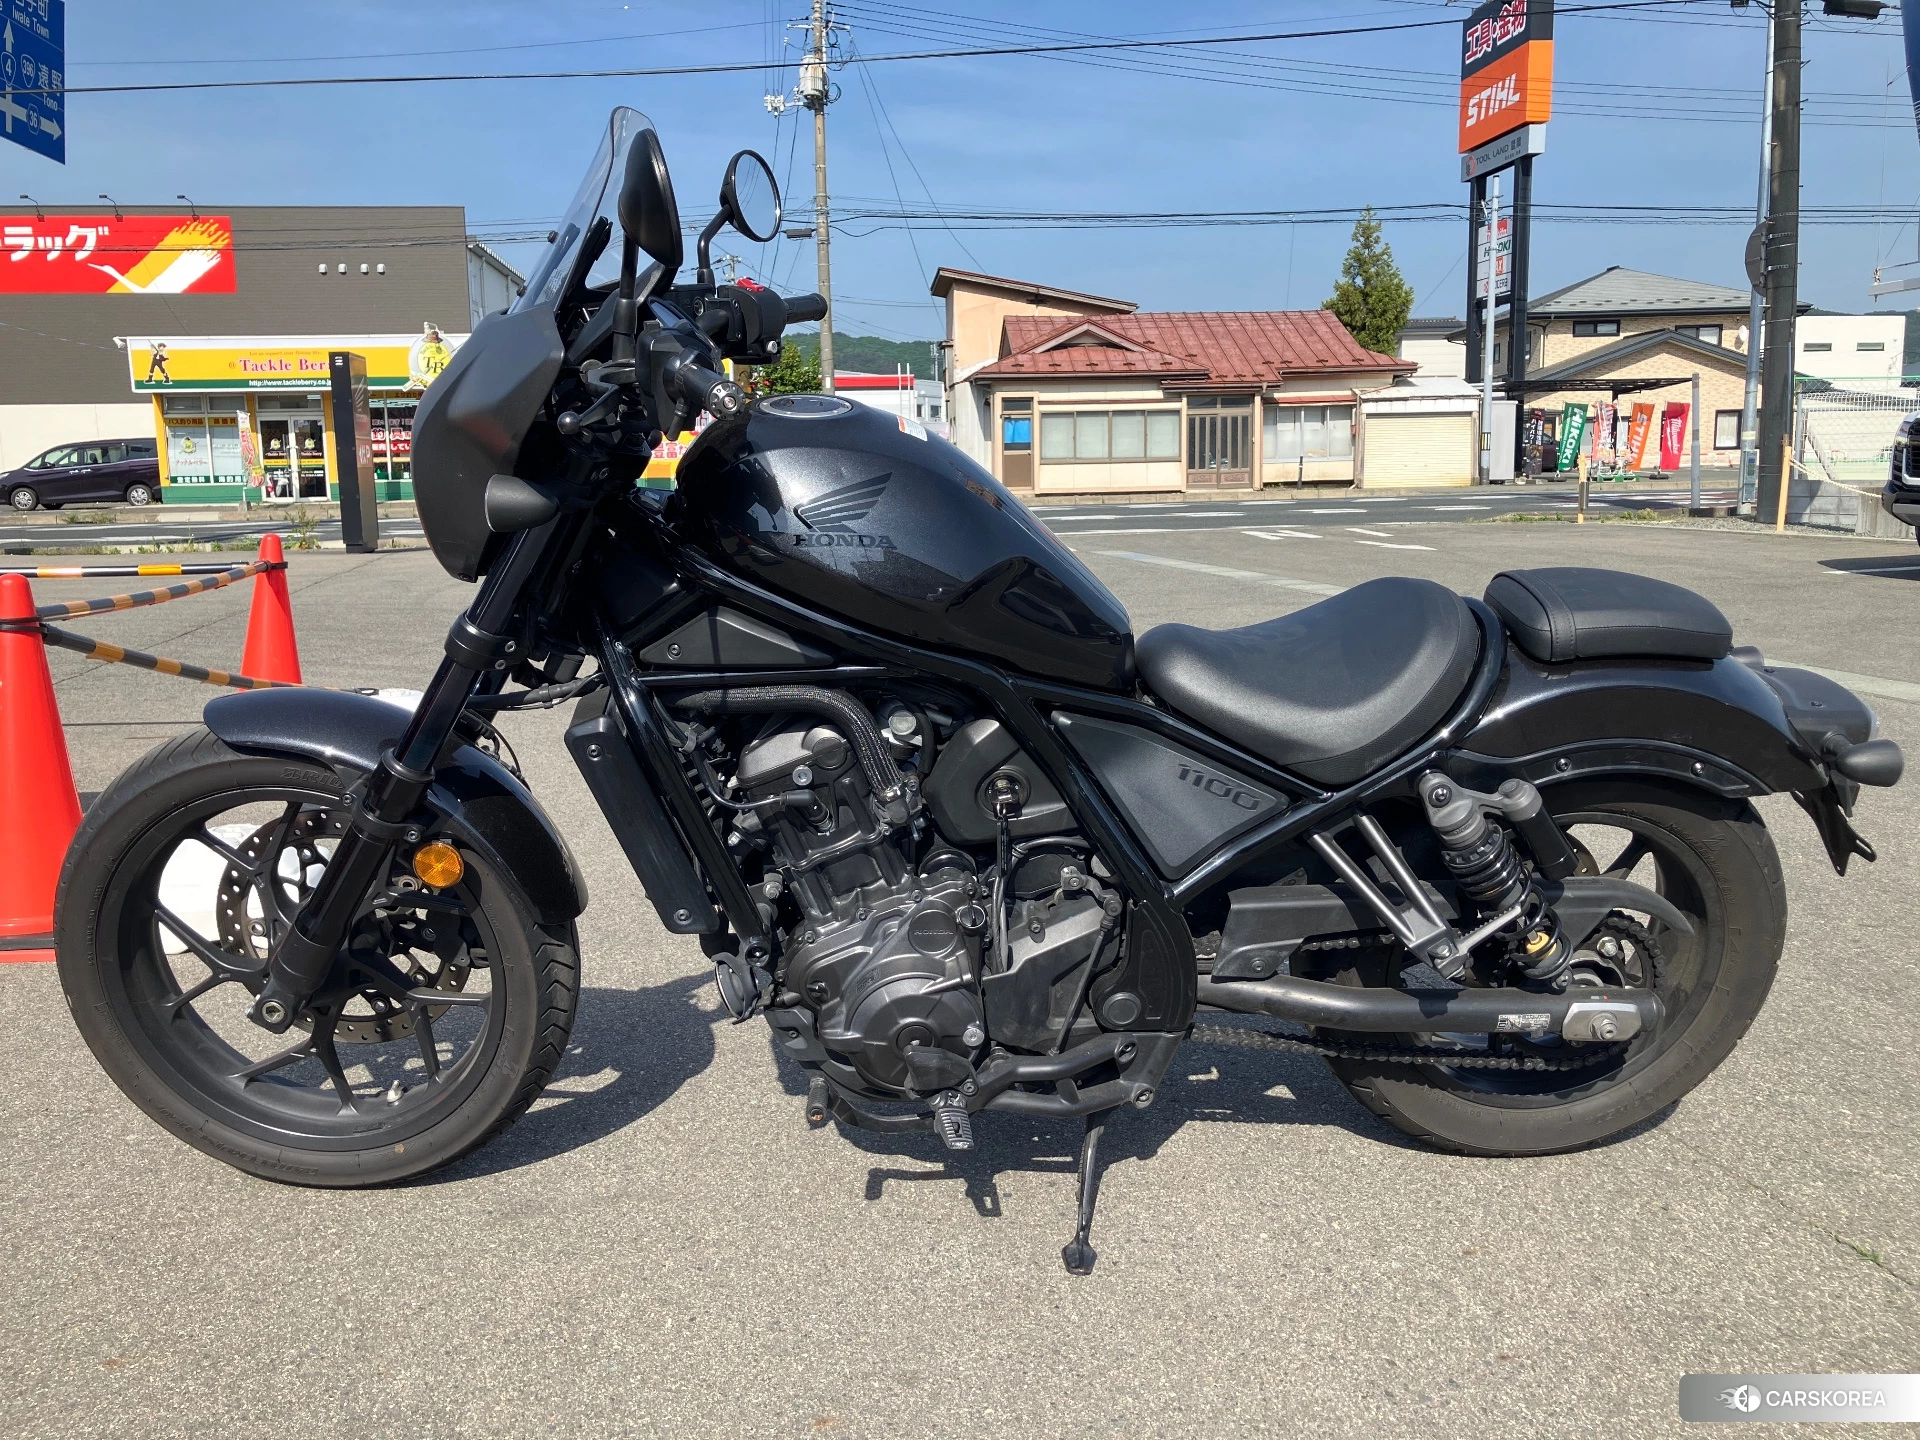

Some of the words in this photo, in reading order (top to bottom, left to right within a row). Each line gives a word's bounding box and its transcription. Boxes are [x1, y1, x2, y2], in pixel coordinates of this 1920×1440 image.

[12, 4, 30, 28] Iwate
[32, 17, 50, 39] Town
[5, 58, 12, 76] 4
[22, 59, 34, 78] 396
[38, 62, 63, 96] 遠野
[42, 93, 58, 112] Tono
[1465, 73, 1520, 128] STIHL
[29, 110, 38, 129] 36
[1475, 152, 1491, 166] TOOL
[1492, 143, 1509, 158] LAND
[0, 224, 109, 262] ラッグ
[1483, 239, 1512, 258] HOKI
[240, 359, 292, 372] Tackle
[299, 358, 331, 371] Ber
[1562, 407, 1584, 464] HiKOKI
[792, 534, 898, 551] HONDA
[1177, 763, 1262, 811] 1100
[913, 928, 954, 936] HONDA
